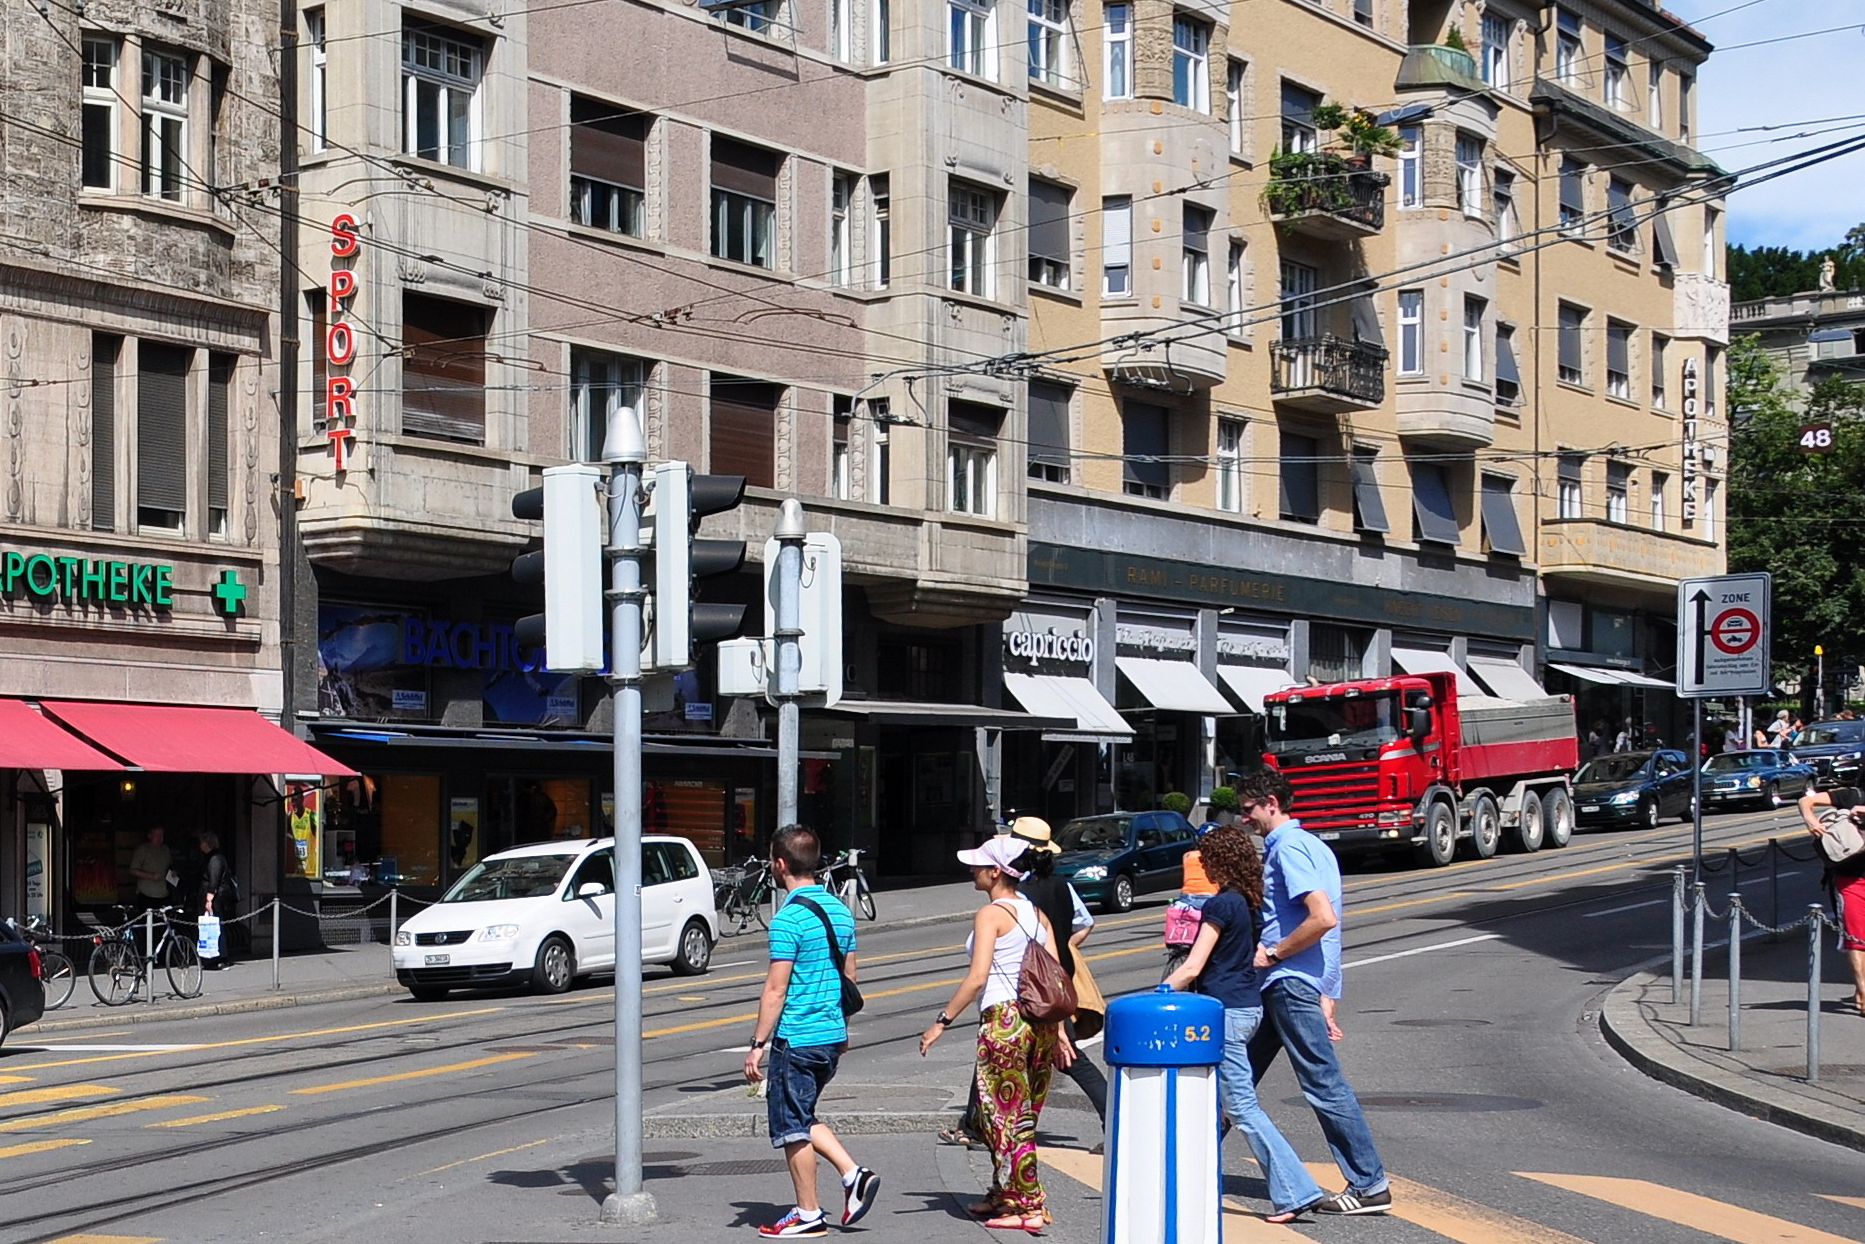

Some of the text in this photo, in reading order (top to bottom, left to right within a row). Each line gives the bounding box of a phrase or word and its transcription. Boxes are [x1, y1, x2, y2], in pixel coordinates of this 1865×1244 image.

[327, 213, 359, 470] SPORT
[1684, 357, 1698, 520] APOTHEKE
[1800, 429, 1831, 448] 48
[1189, 573, 1286, 602] PARFUMERIE
[1721, 592, 1751, 604] ZONE
[404, 616, 547, 673] BÄCHTO
[1009, 626, 1093, 666] capriccio
[1305, 753, 1347, 764] SCANIA
[1184, 1025, 1211, 1042] 5.2
